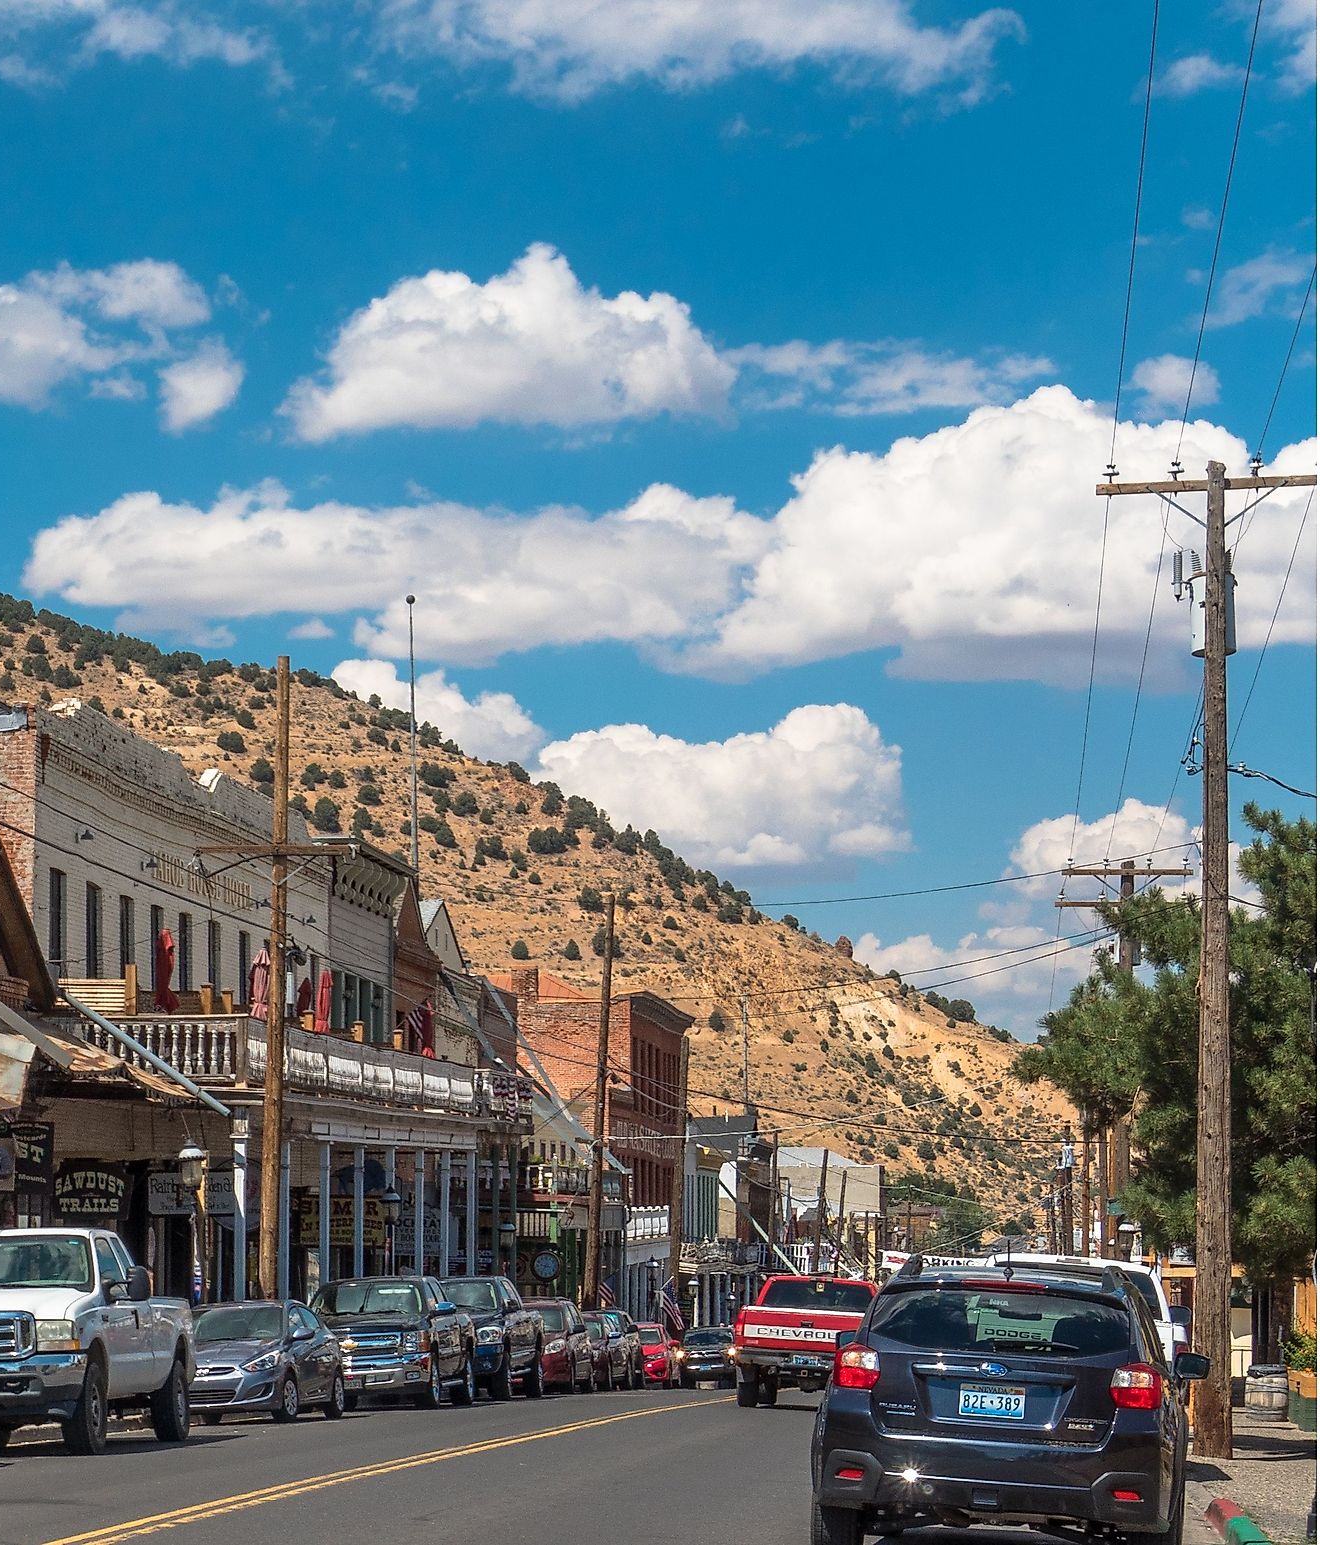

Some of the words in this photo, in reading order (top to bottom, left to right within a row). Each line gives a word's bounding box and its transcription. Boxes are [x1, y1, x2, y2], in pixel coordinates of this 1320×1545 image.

[16, 1141, 45, 1164] ST
[18, 1174, 48, 1184] Mounts
[56, 1171, 125, 1198] SAWDUST
[60, 1198, 120, 1213] TRAILS
[923, 1256, 974, 1267] ARKING
[757, 1327, 836, 1340] CHEVROL
[984, 1328, 1042, 1340] DODGE
[978, 1386, 1009, 1395] NEVADA
